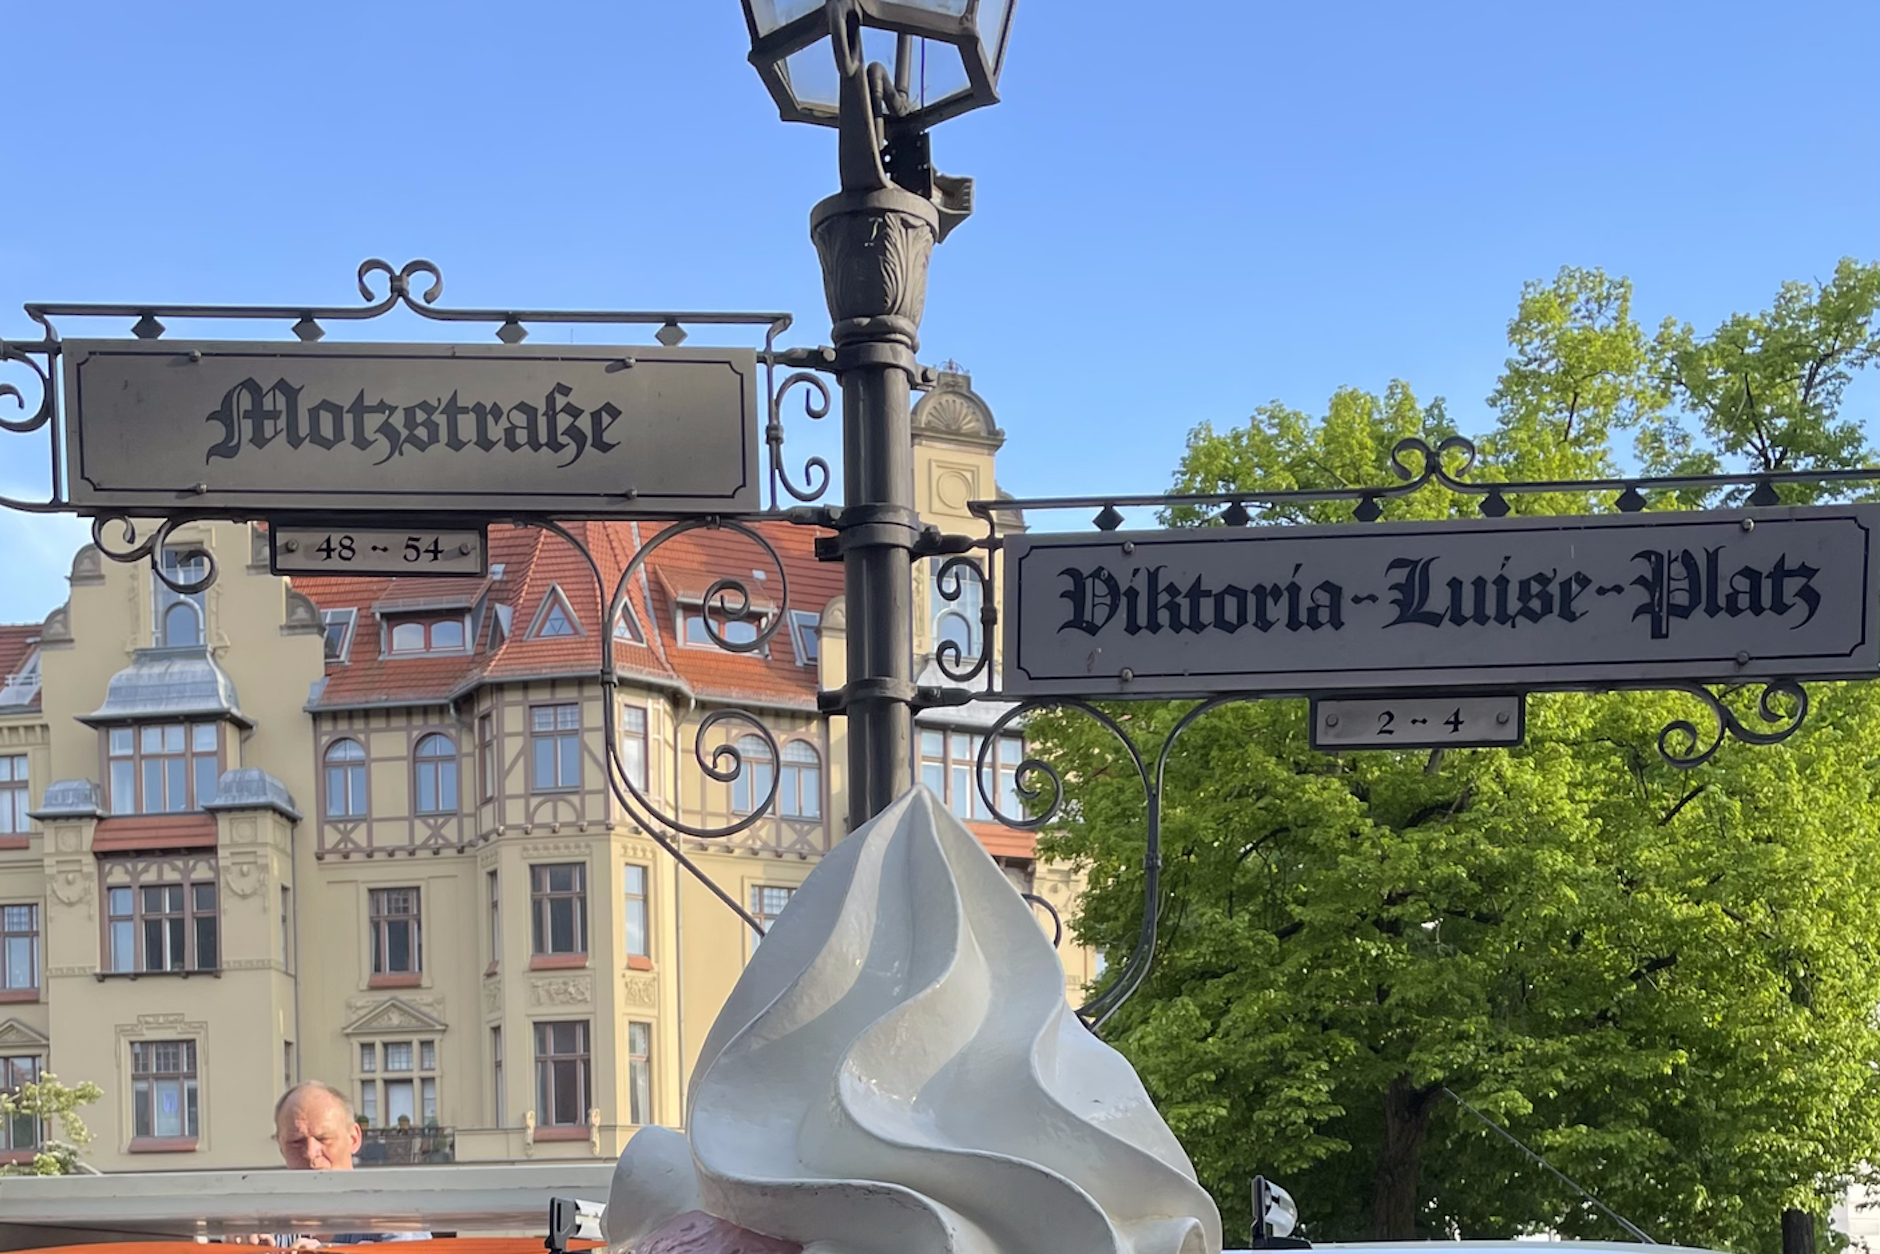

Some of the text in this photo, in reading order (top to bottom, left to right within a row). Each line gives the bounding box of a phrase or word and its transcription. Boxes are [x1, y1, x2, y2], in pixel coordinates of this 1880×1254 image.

[205, 376, 623, 468] Motzstraße
[315, 534, 357, 562] 48
[402, 535, 445, 563] 54
[1056, 545, 1822, 640] Viktoria-Luise-Platz
[1377, 709, 1395, 735] 2
[1443, 707, 1465, 734] 4
